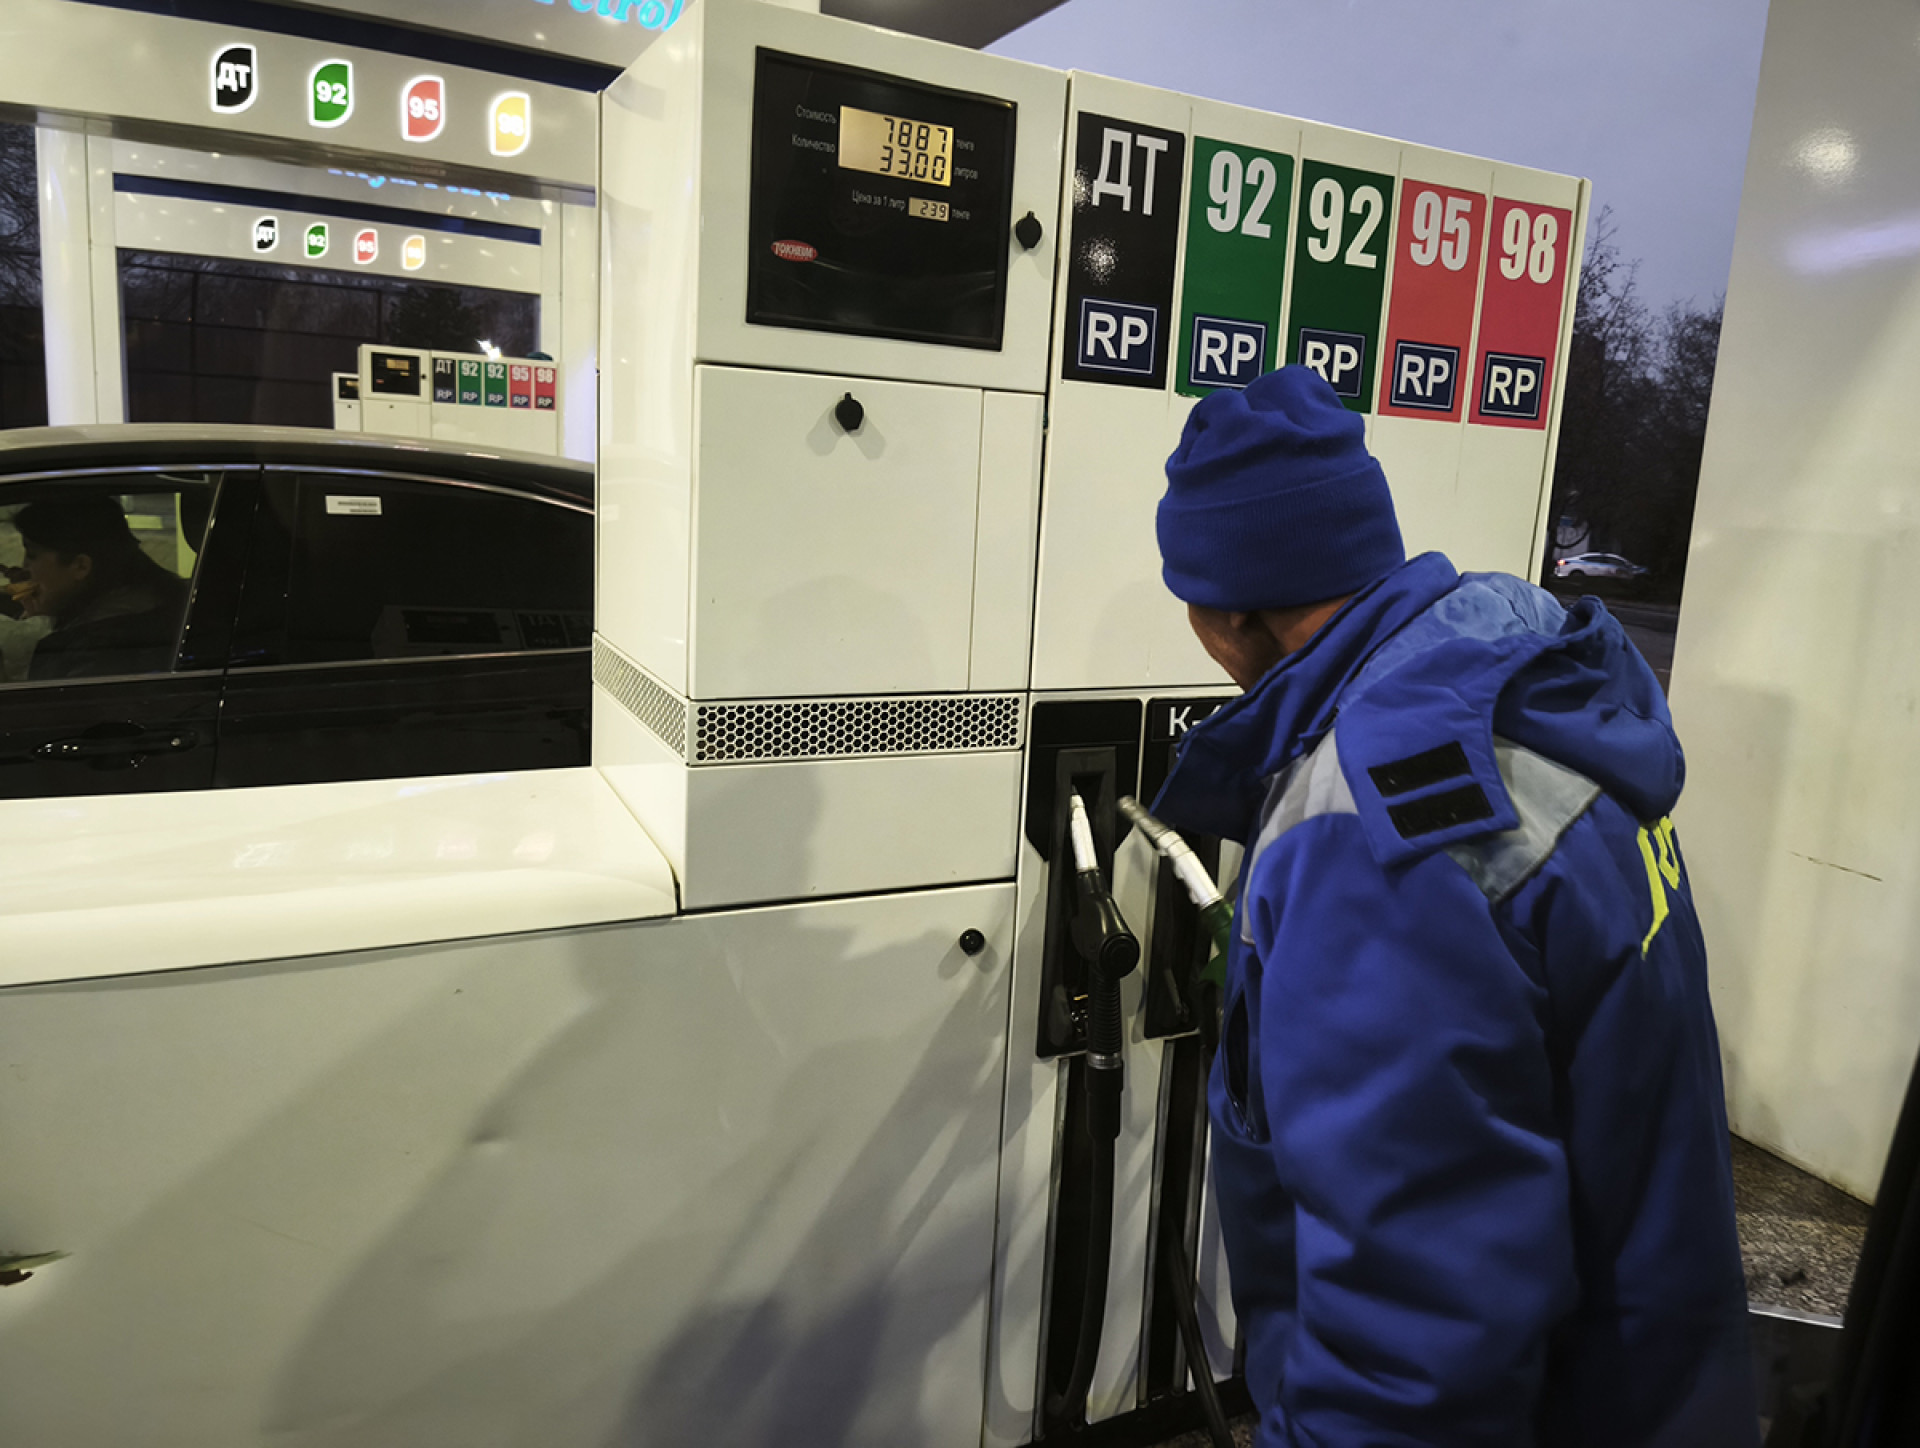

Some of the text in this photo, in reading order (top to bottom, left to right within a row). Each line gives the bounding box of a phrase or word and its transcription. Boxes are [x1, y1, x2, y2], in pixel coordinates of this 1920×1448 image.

[217, 62, 250, 92] ДТ
[316, 80, 347, 105] 92
[409, 96, 439, 121] 95
[884, 117, 948, 153] 7887
[1092, 127, 1168, 216] ДТ
[920, 201, 947, 218] 239
[1207, 150, 1277, 239] 92
[1308, 178, 1384, 269] 92
[1410, 190, 1472, 271] 95
[1500, 207, 1558, 284] 98
[1086, 310, 1149, 361] RP
[1198, 328, 1257, 377] RP
[461, 361, 478, 377] 92
[487, 363, 505, 379] 92
[512, 366, 529, 381] 95
[537, 368, 553, 383] 98
[1305, 338, 1359, 384] RP
[1400, 354, 1449, 398] RP
[1488, 366, 1536, 407] RP
